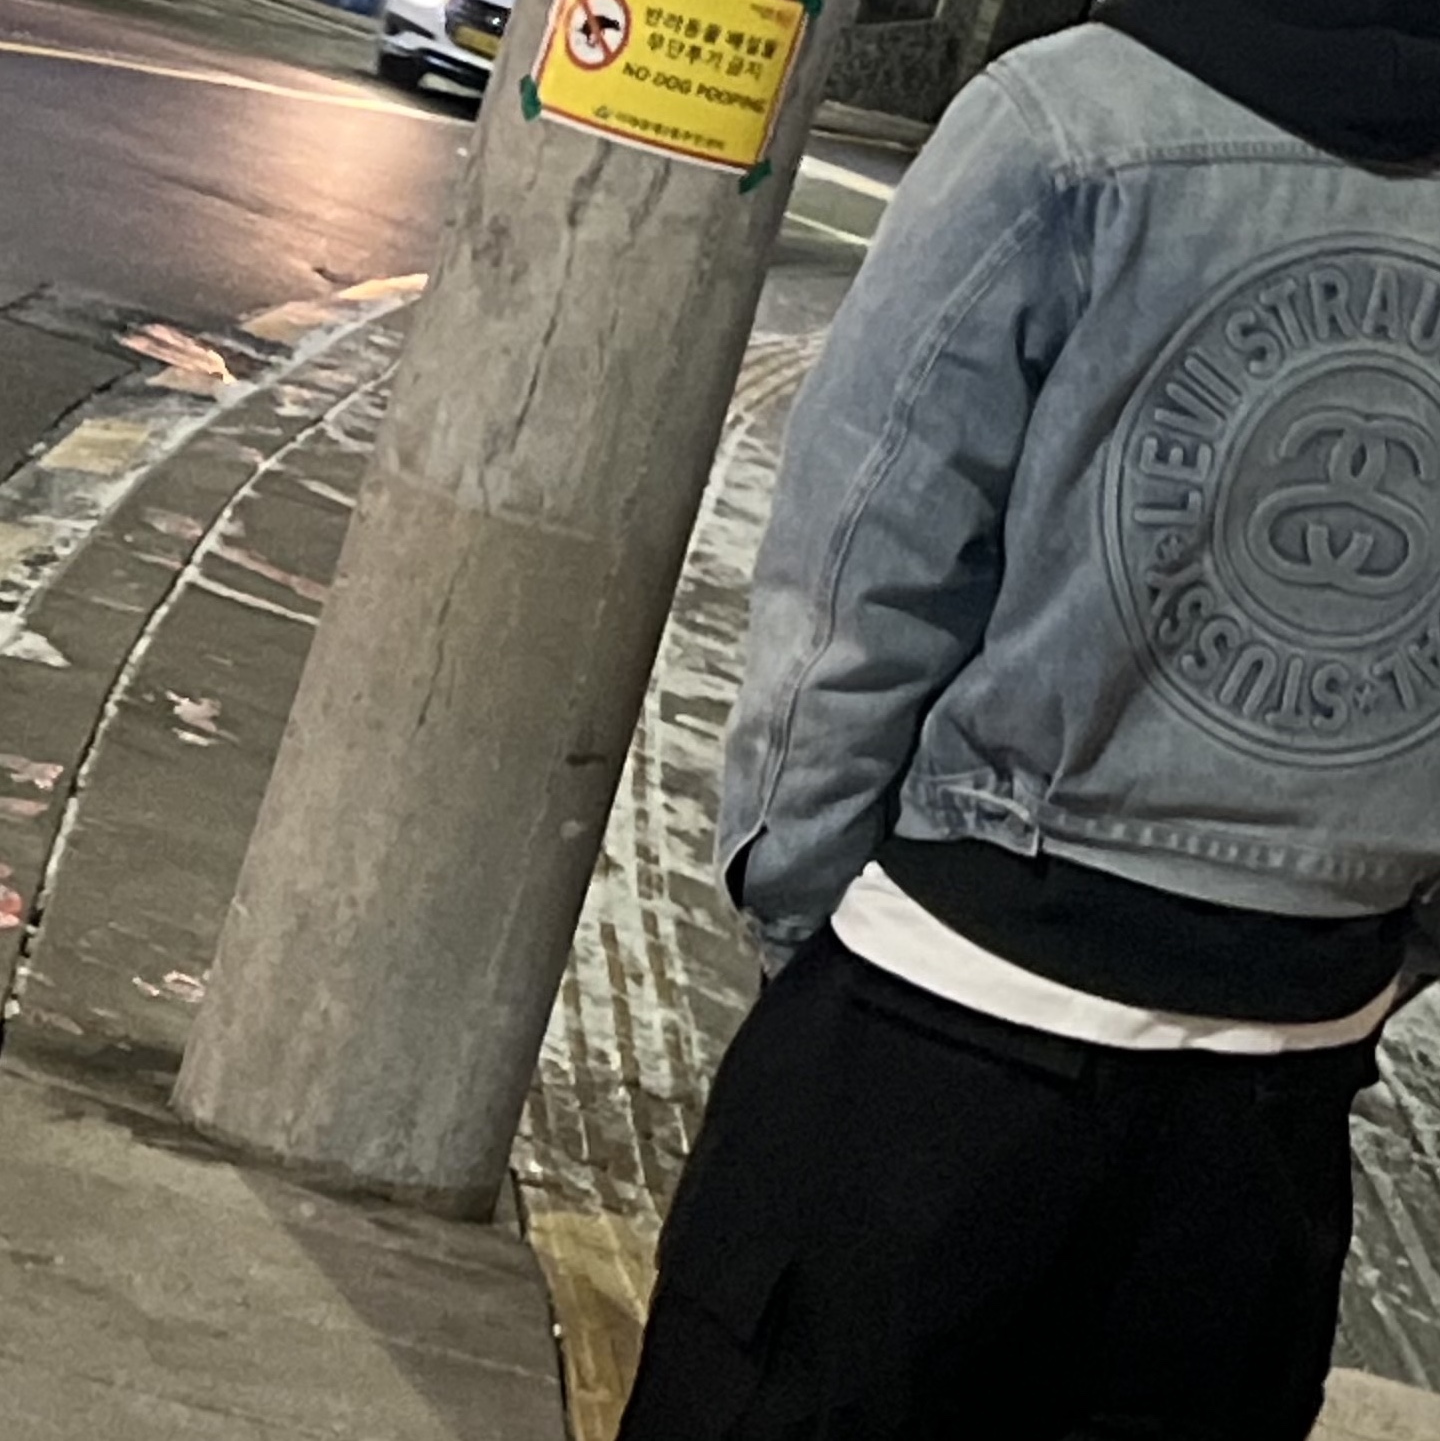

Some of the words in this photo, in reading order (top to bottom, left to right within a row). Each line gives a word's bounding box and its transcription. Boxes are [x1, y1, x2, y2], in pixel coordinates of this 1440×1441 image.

[623, 62, 651, 82] NO
[653, 71, 693, 95] DOG
[1134, 353, 1243, 526] LEVI
[1144, 567, 1351, 731] STUSSY
